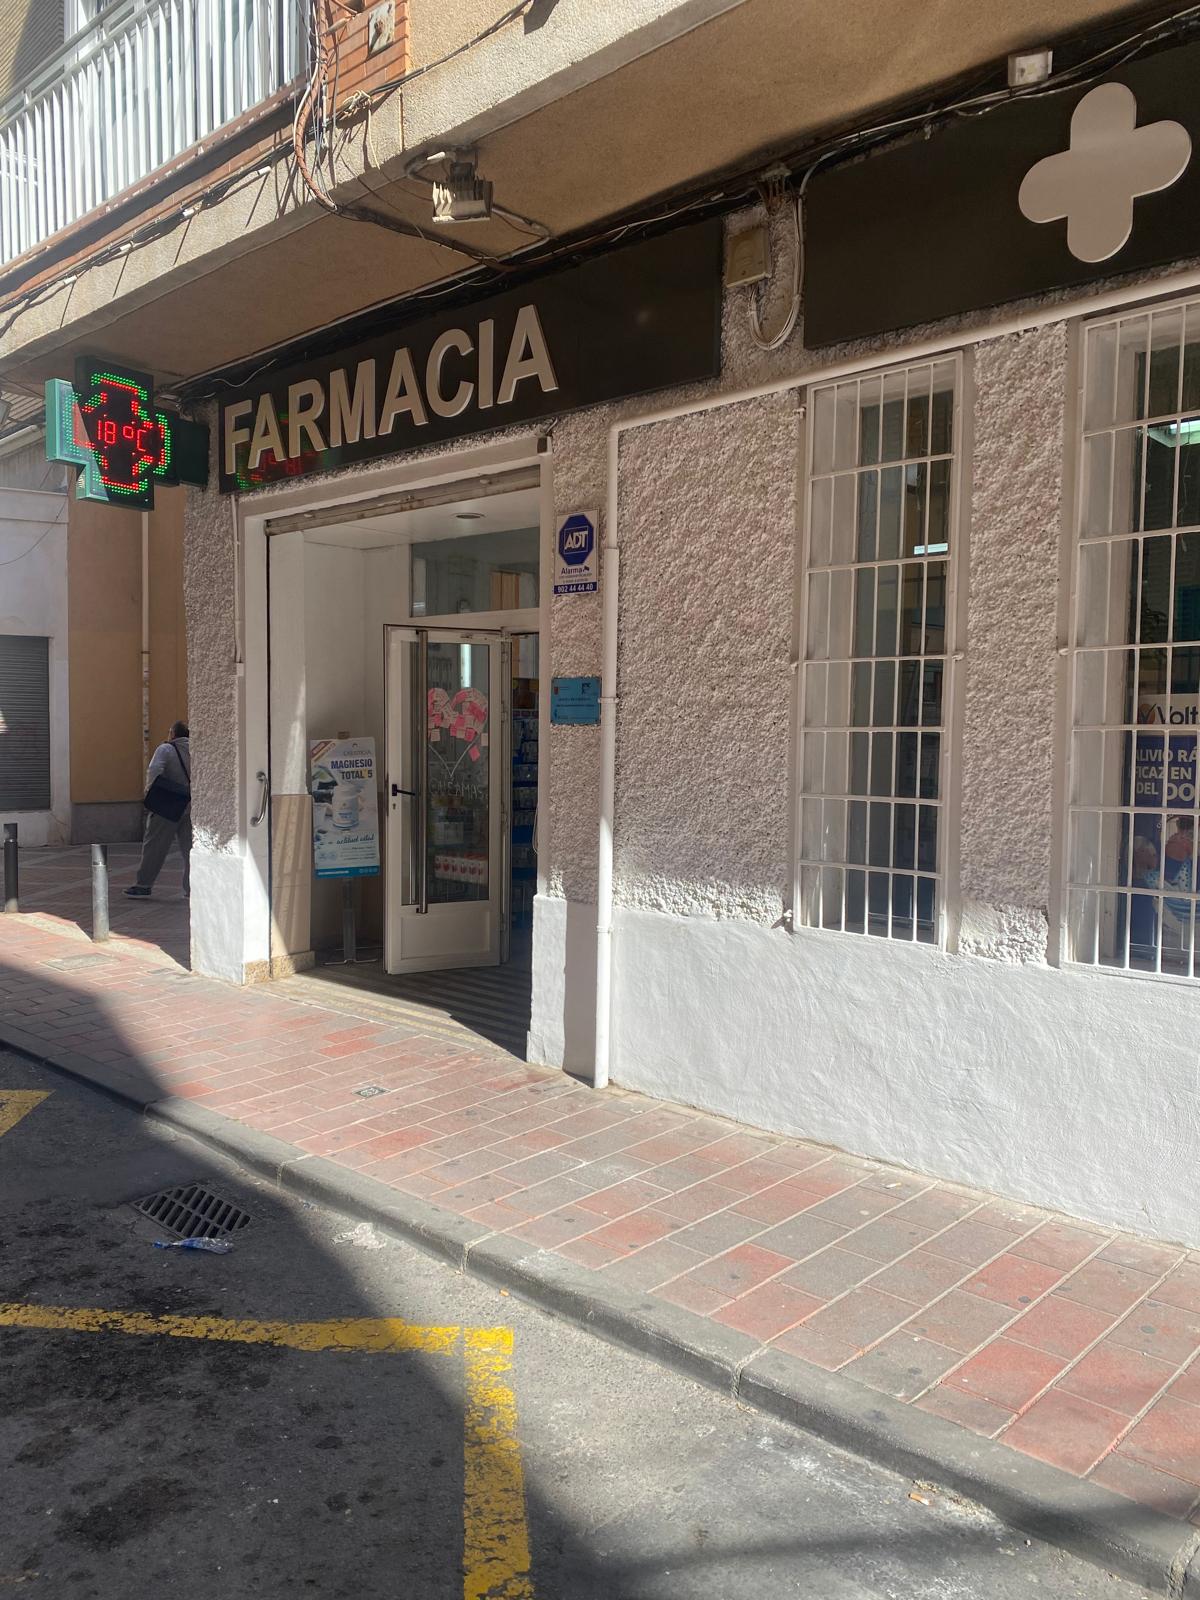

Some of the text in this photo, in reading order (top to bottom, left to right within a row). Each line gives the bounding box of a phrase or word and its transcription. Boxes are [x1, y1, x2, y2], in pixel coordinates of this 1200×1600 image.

[224, 304, 559, 475] FARMACIA
[564, 530, 589, 550] ADT
[561, 567, 583, 575] Alarma
[569, 584, 576, 592] 44
[586, 583, 593, 591] 40
[331, 759, 373, 769] MAGNESIO
[341, 769, 373, 780] TOTAL 5
[1171, 766, 1192, 780] EN
[1136, 782, 1159, 795] DEL
